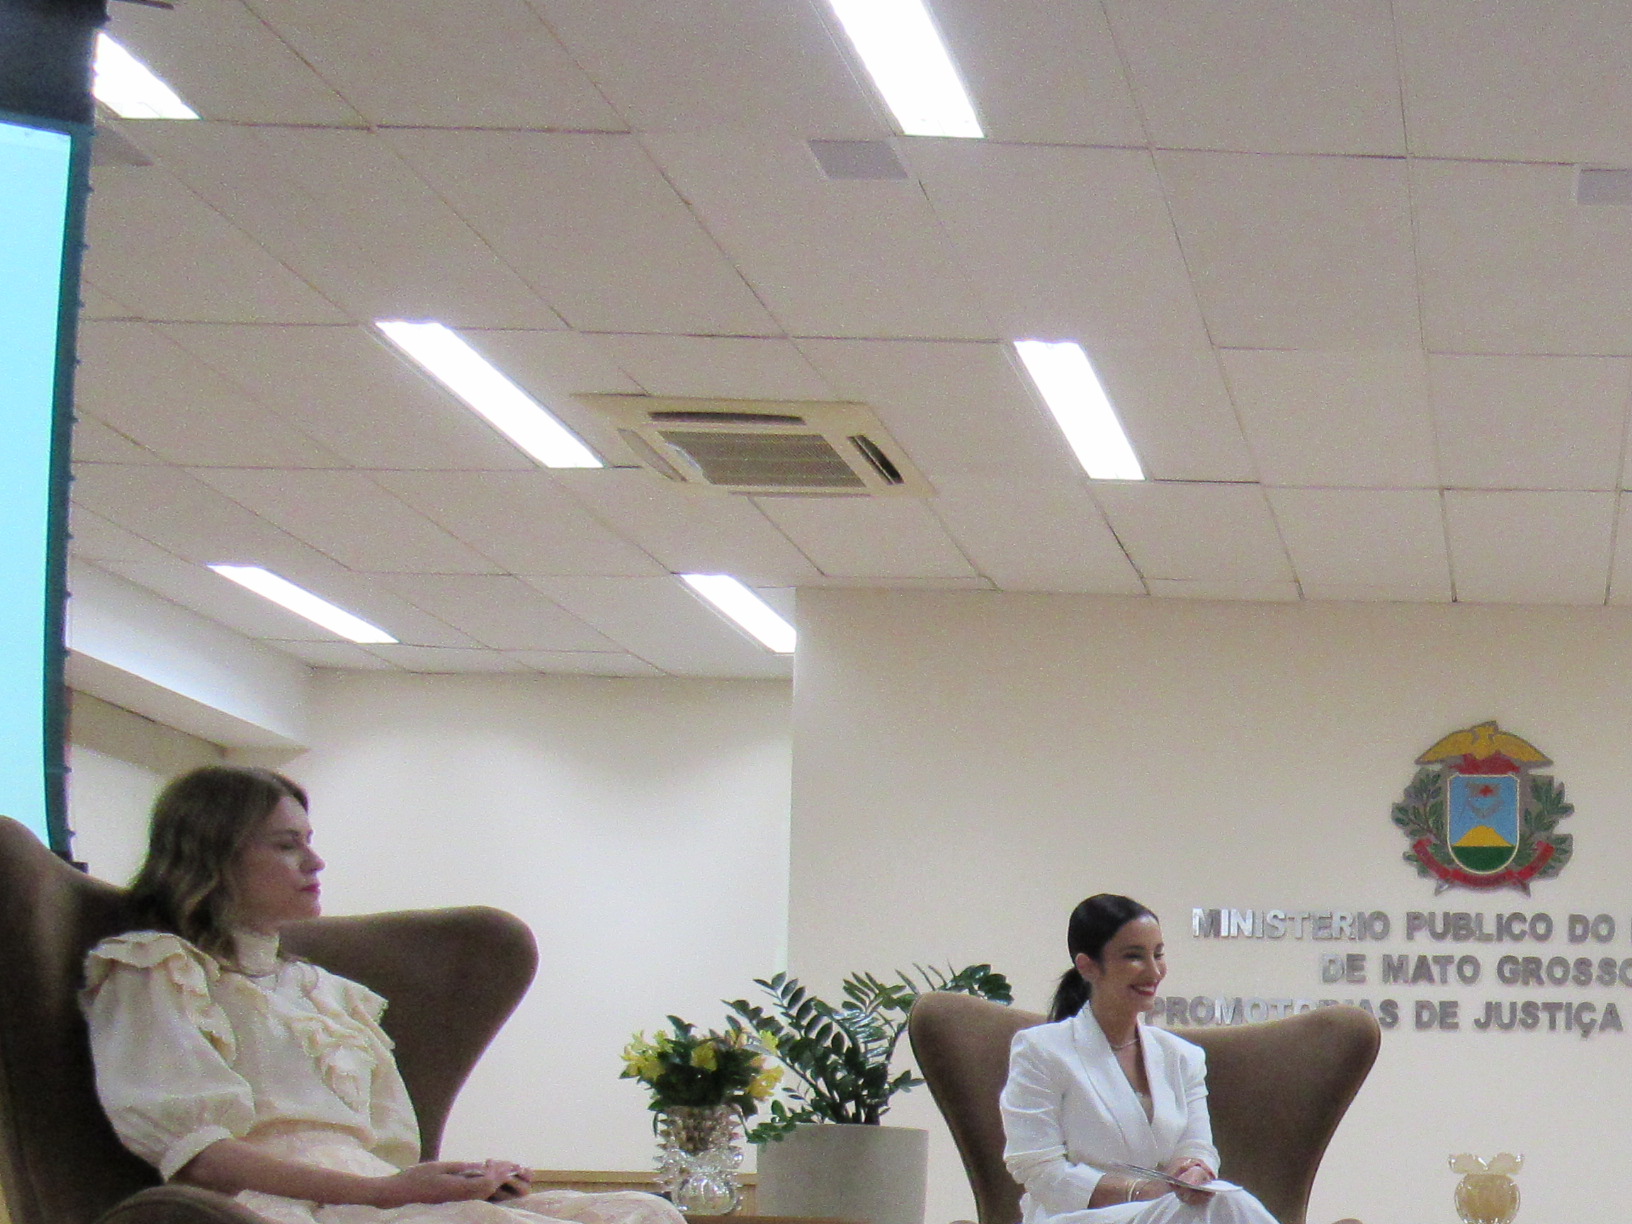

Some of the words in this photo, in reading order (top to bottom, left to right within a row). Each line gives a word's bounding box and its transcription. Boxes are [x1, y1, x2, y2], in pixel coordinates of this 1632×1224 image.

[1192, 907, 1391, 940] MINISTERIO
[1406, 911, 1554, 942] PUBLICO
[1568, 913, 1616, 943] DO
[1321, 952, 1367, 984] DE
[1382, 954, 1482, 984] MATO
[1144, 996, 1399, 1028] PROMOTS
[1415, 1000, 1460, 1030] DE
[1473, 1000, 1624, 1039] JUSTIÇA
